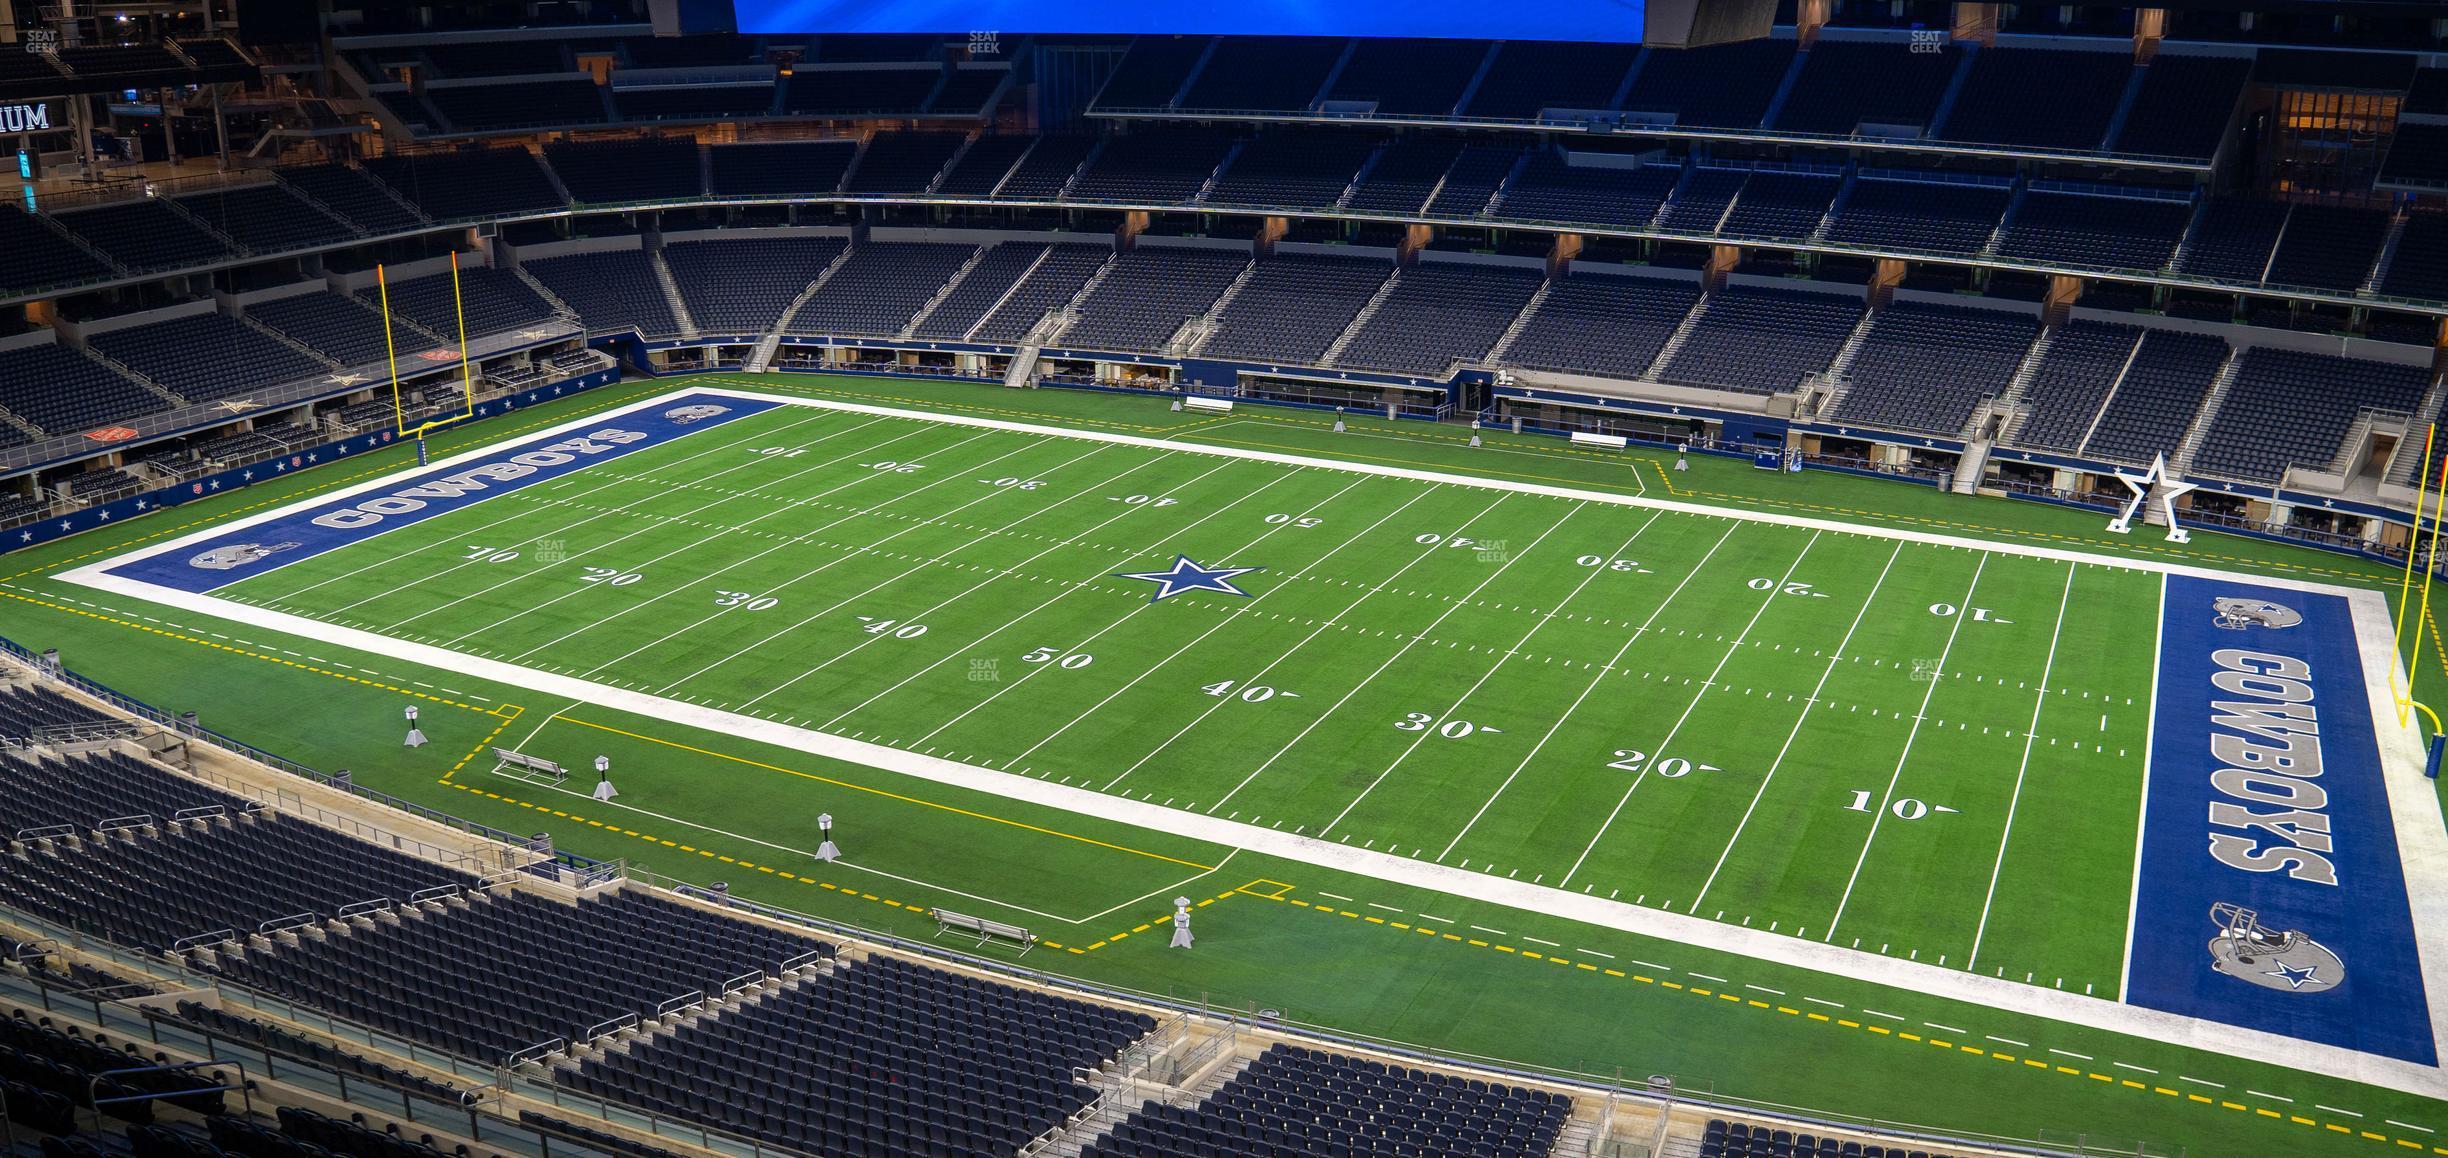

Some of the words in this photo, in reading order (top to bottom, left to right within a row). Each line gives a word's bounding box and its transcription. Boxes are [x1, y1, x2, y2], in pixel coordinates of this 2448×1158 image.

[760, 446, 810, 459] 10
[872, 461, 926, 474] 20
[311, 429, 648, 529] COWBOYS
[992, 477, 1048, 491] 30
[1124, 494, 1179, 508] 40
[1264, 513, 1323, 529] 50
[1415, 533, 1475, 549] 40
[462, 546, 520, 563] 10
[1576, 554, 1640, 572] 30
[580, 567, 643, 586] 20
[1747, 577, 1813, 596] 20
[714, 591, 779, 611] 30
[1928, 603, 1993, 622] 10
[863, 619, 928, 639] 40
[1021, 646, 1094, 669] 50
[1200, 679, 1275, 703] 40
[1394, 712, 1474, 739] 30
[1606, 749, 1692, 778] 20
[2208, 649, 2339, 887] COWBOYS
[1843, 789, 1928, 820] 10
